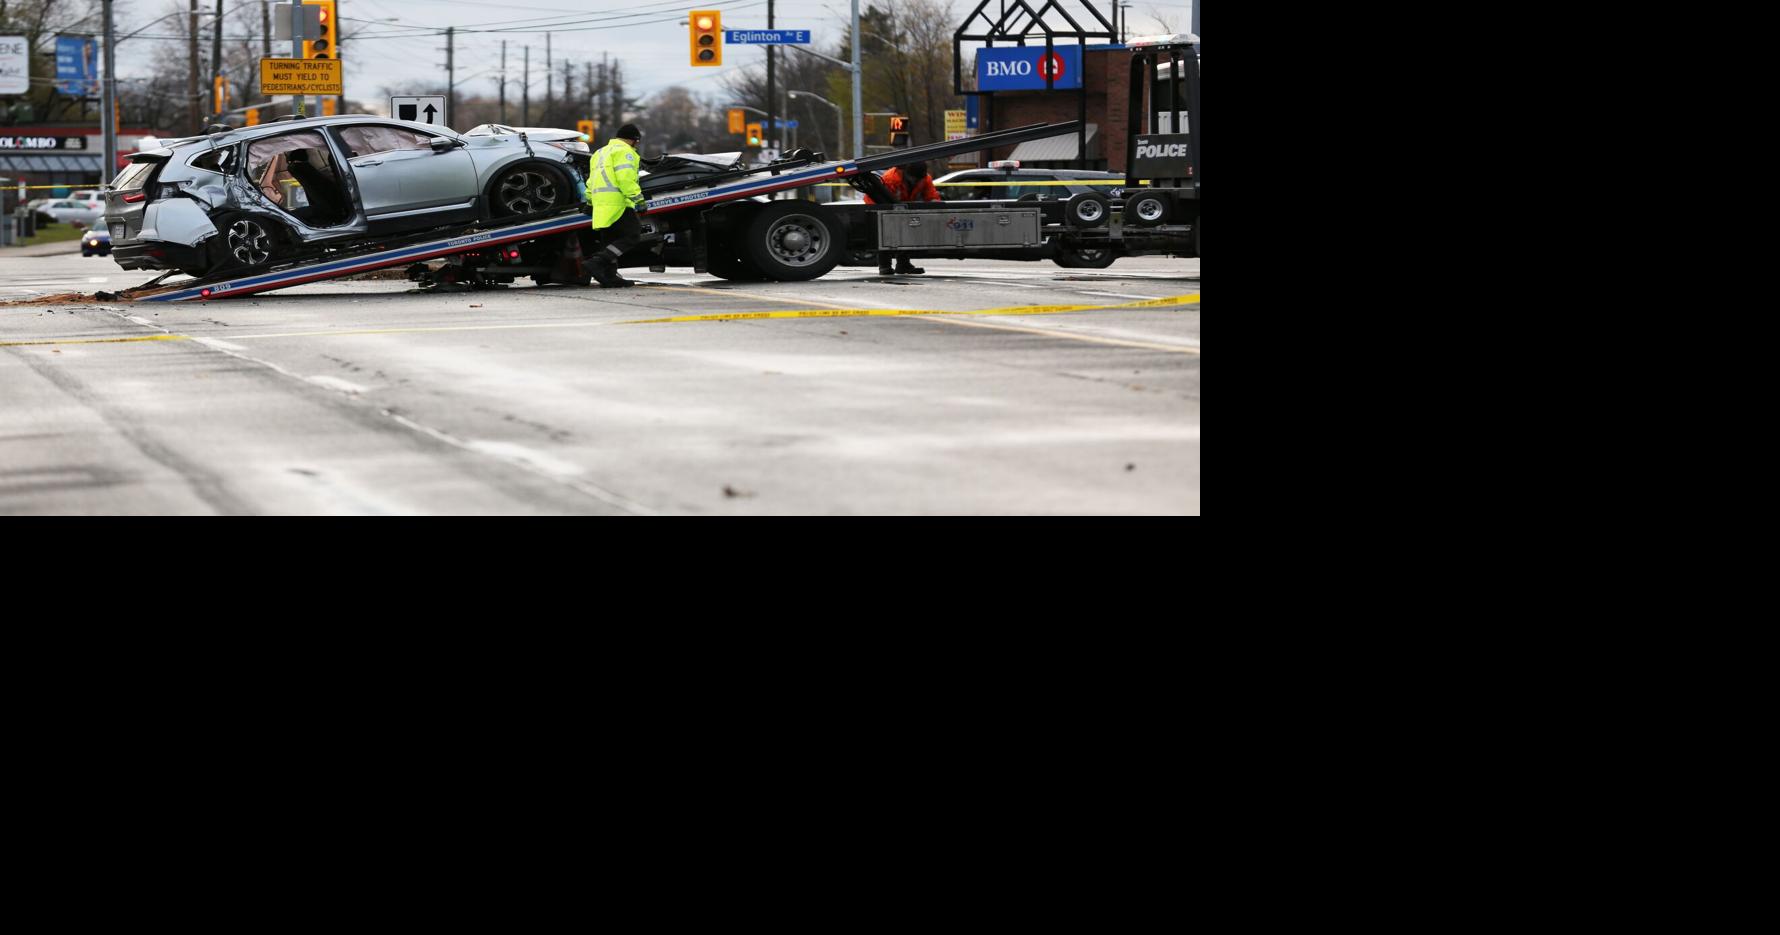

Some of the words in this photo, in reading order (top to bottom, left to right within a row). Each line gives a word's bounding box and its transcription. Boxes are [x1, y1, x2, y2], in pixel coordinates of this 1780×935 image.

[733, 31, 781, 43] Eglinton
[797, 32, 803, 41] E
[987, 60, 1031, 76] BMO
[1136, 144, 1187, 158] POLICE
[653, 198, 673, 206] SERVE
[681, 192, 709, 202] PROTECT
[473, 233, 491, 241] POLICE
